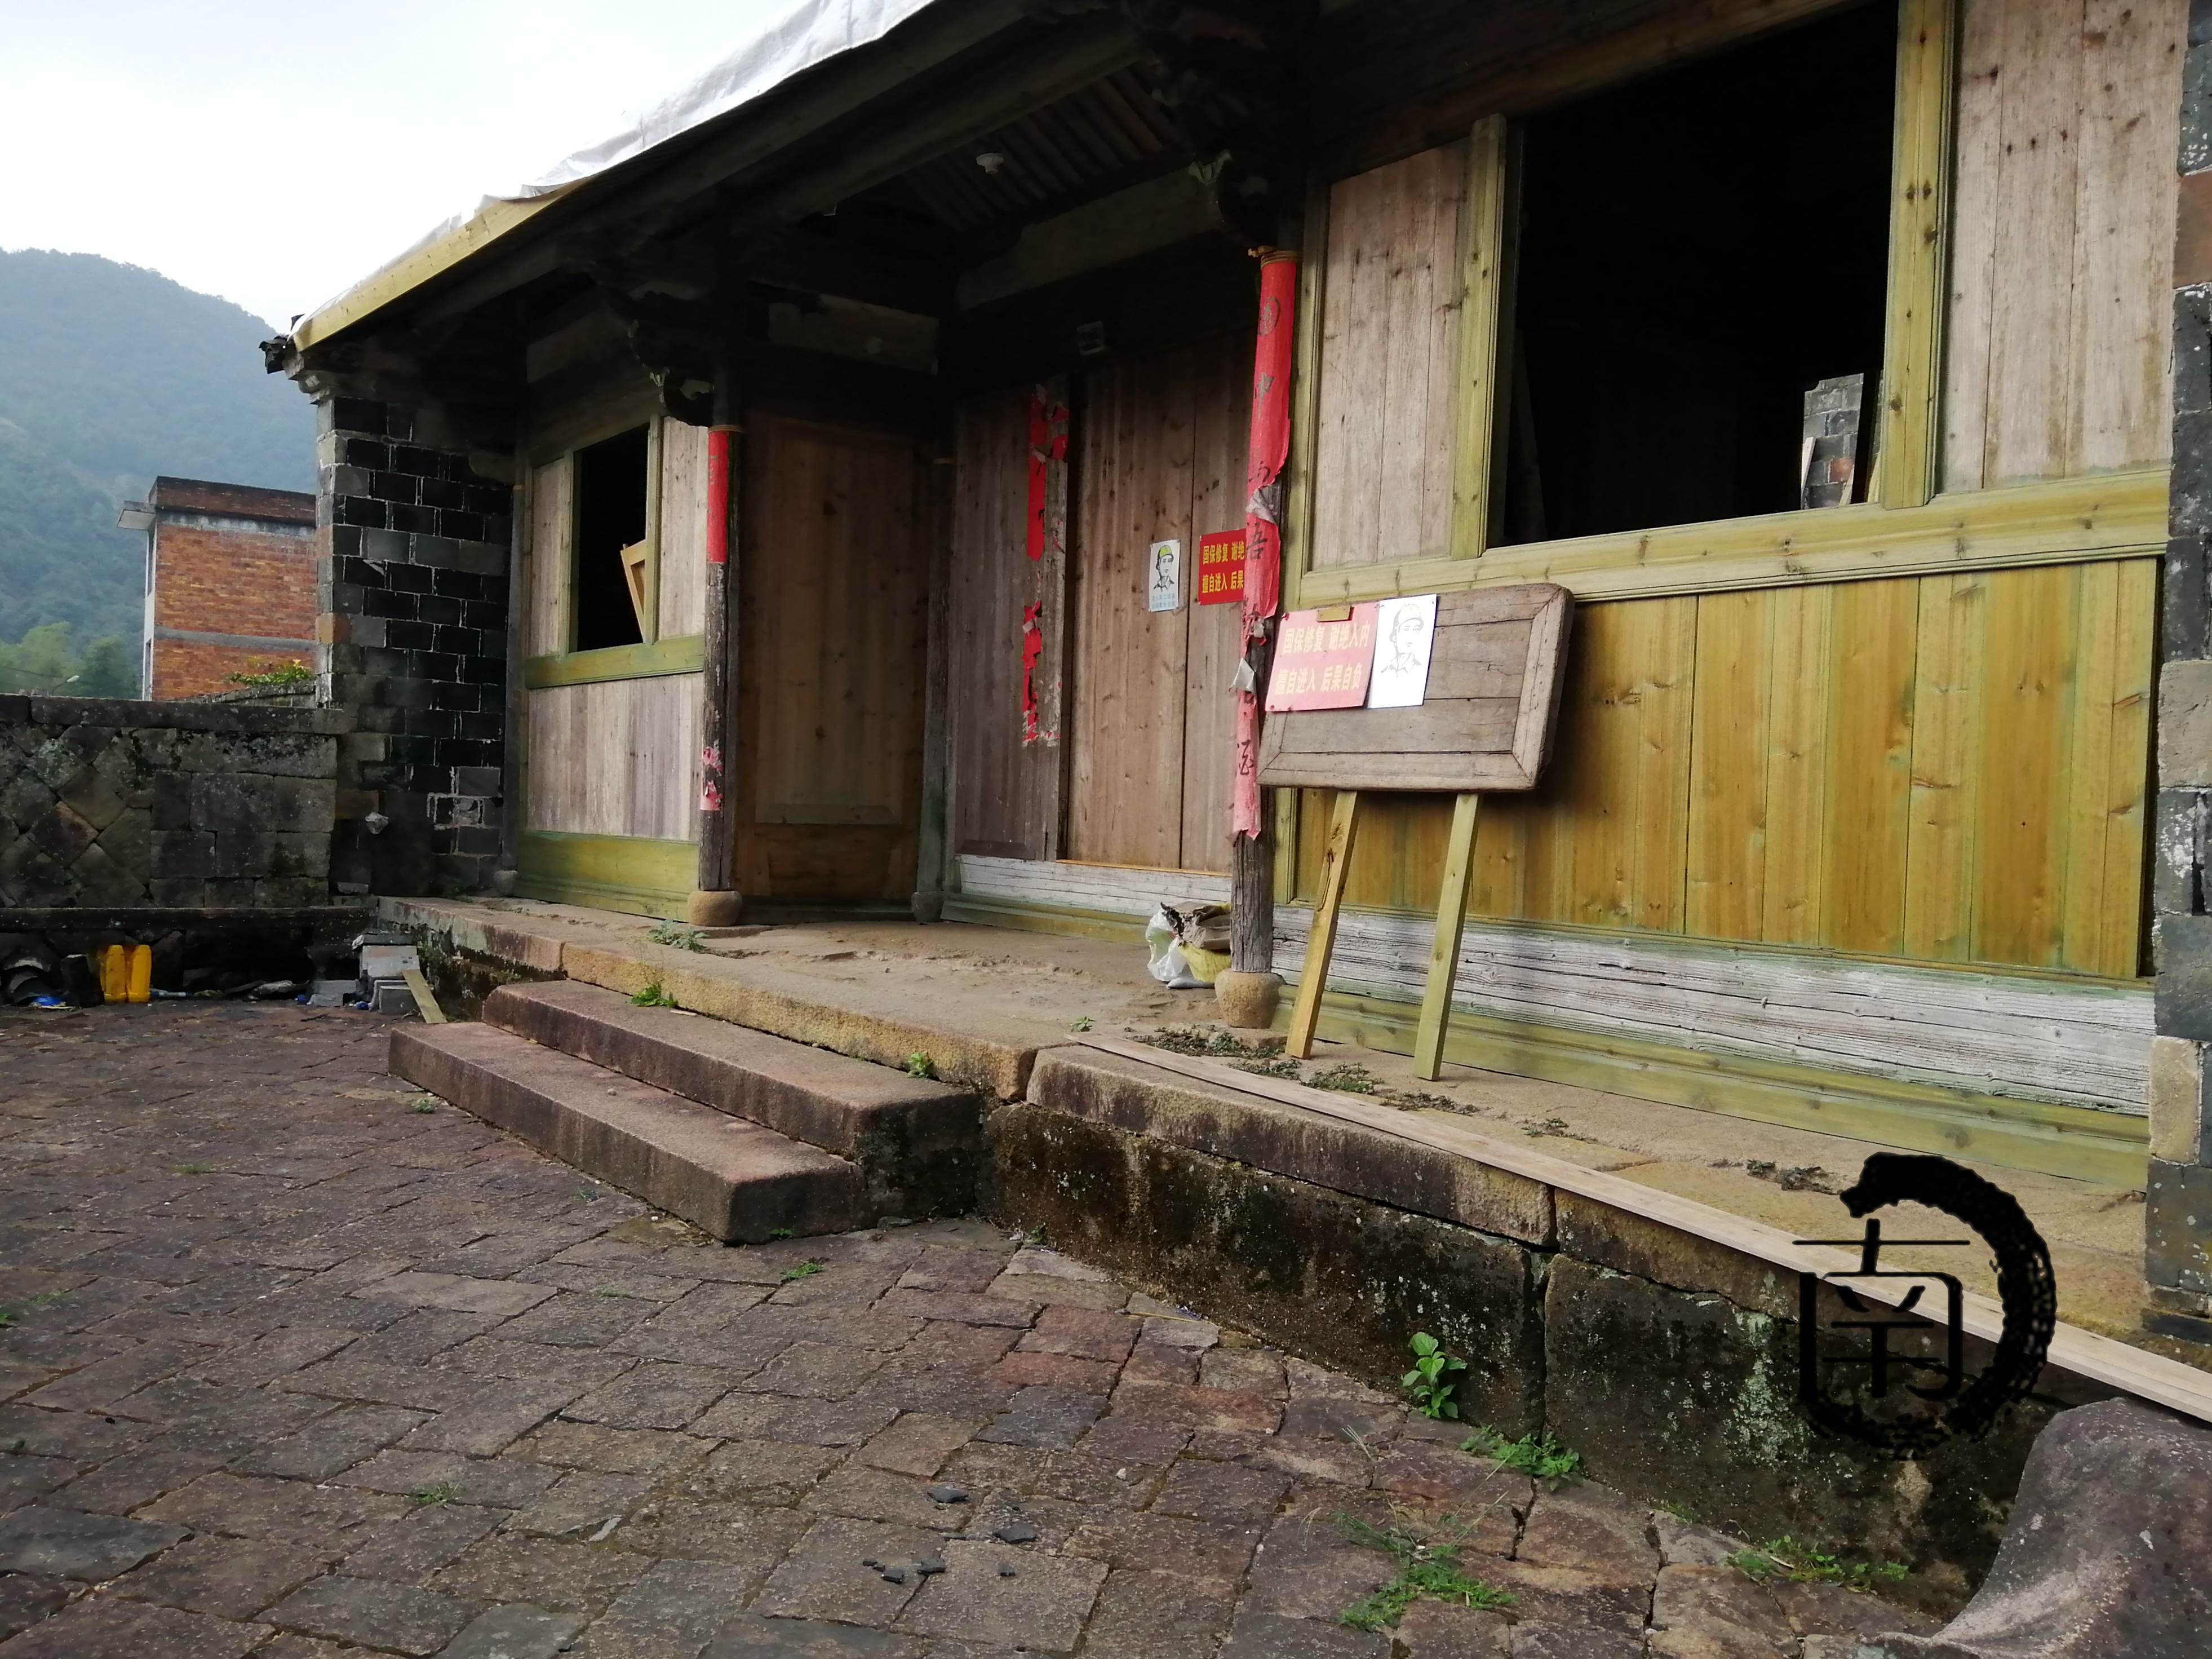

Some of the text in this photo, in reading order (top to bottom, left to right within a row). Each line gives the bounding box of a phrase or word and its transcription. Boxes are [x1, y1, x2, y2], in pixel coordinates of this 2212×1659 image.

[1203, 541, 1245, 565] 国保修复 谢绝
[1202, 570, 1244, 593] 擅自进入 后果
[1282, 621, 1371, 654] 国保修复 谢绝入内
[1275, 663, 1363, 694] 擅自进入 后果自负
